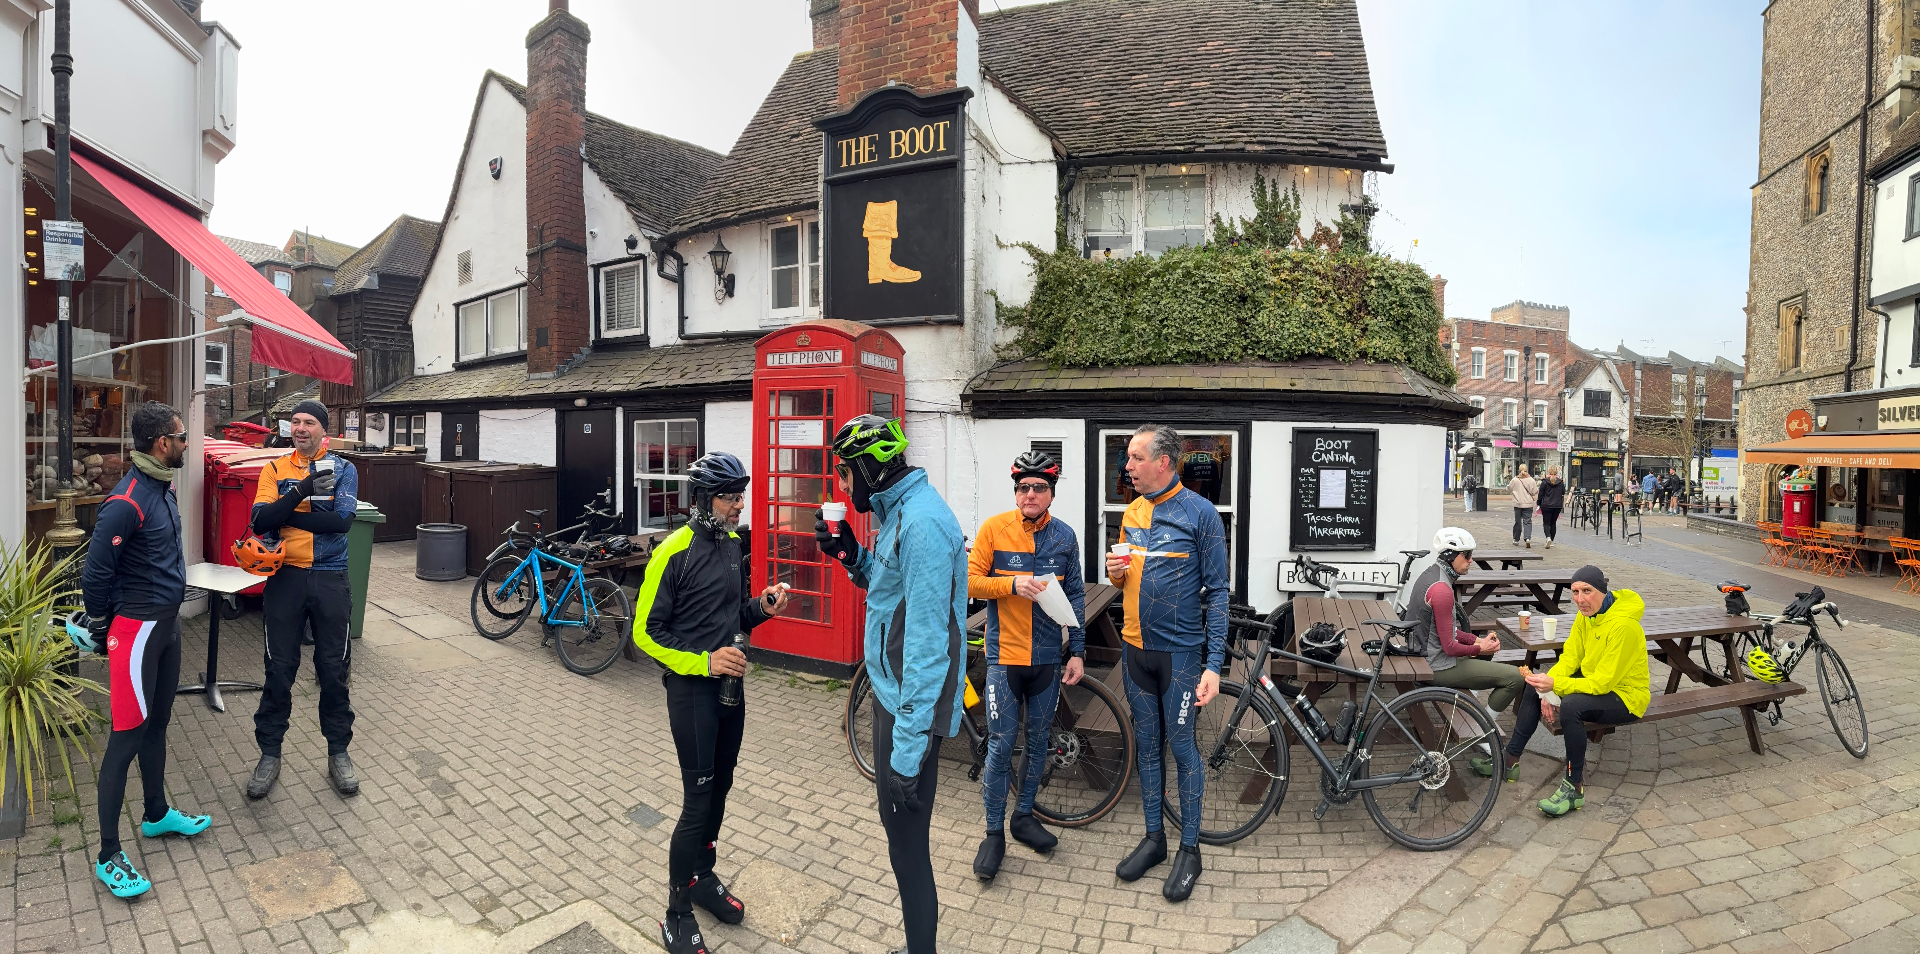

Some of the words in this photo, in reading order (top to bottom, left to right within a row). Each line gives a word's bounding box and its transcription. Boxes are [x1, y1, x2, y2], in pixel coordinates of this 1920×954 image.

[837, 133, 879, 168] THE
[888, 120, 950, 159] BOOT
[45, 229, 83, 239] Responsible
[45, 235, 72, 244] Drinking
[770, 350, 840, 365] TELEPHONE
[861, 351, 897, 371] TELEPHONE
[1314, 438, 1352, 451] BOOT
[1184, 452, 1211, 464] OPEN
[1311, 450, 1357, 465] CANTINA
[1806, 456, 1823, 464] SILVER
[1823, 457, 1843, 465] PALATE
[1849, 456, 1863, 466] CAFÉ
[1865, 457, 1877, 466] AND
[1878, 457, 1893, 466] DELI
[1300, 467, 1316, 475] BAR
[1336, 513, 1361, 525] BIRRIA
[1309, 525, 1362, 539] MARGARITAS
[988, 684, 999, 720] PBCC
[1177, 691, 1191, 725] PBCC
[1282, 704, 1311, 741] TRIBAN
